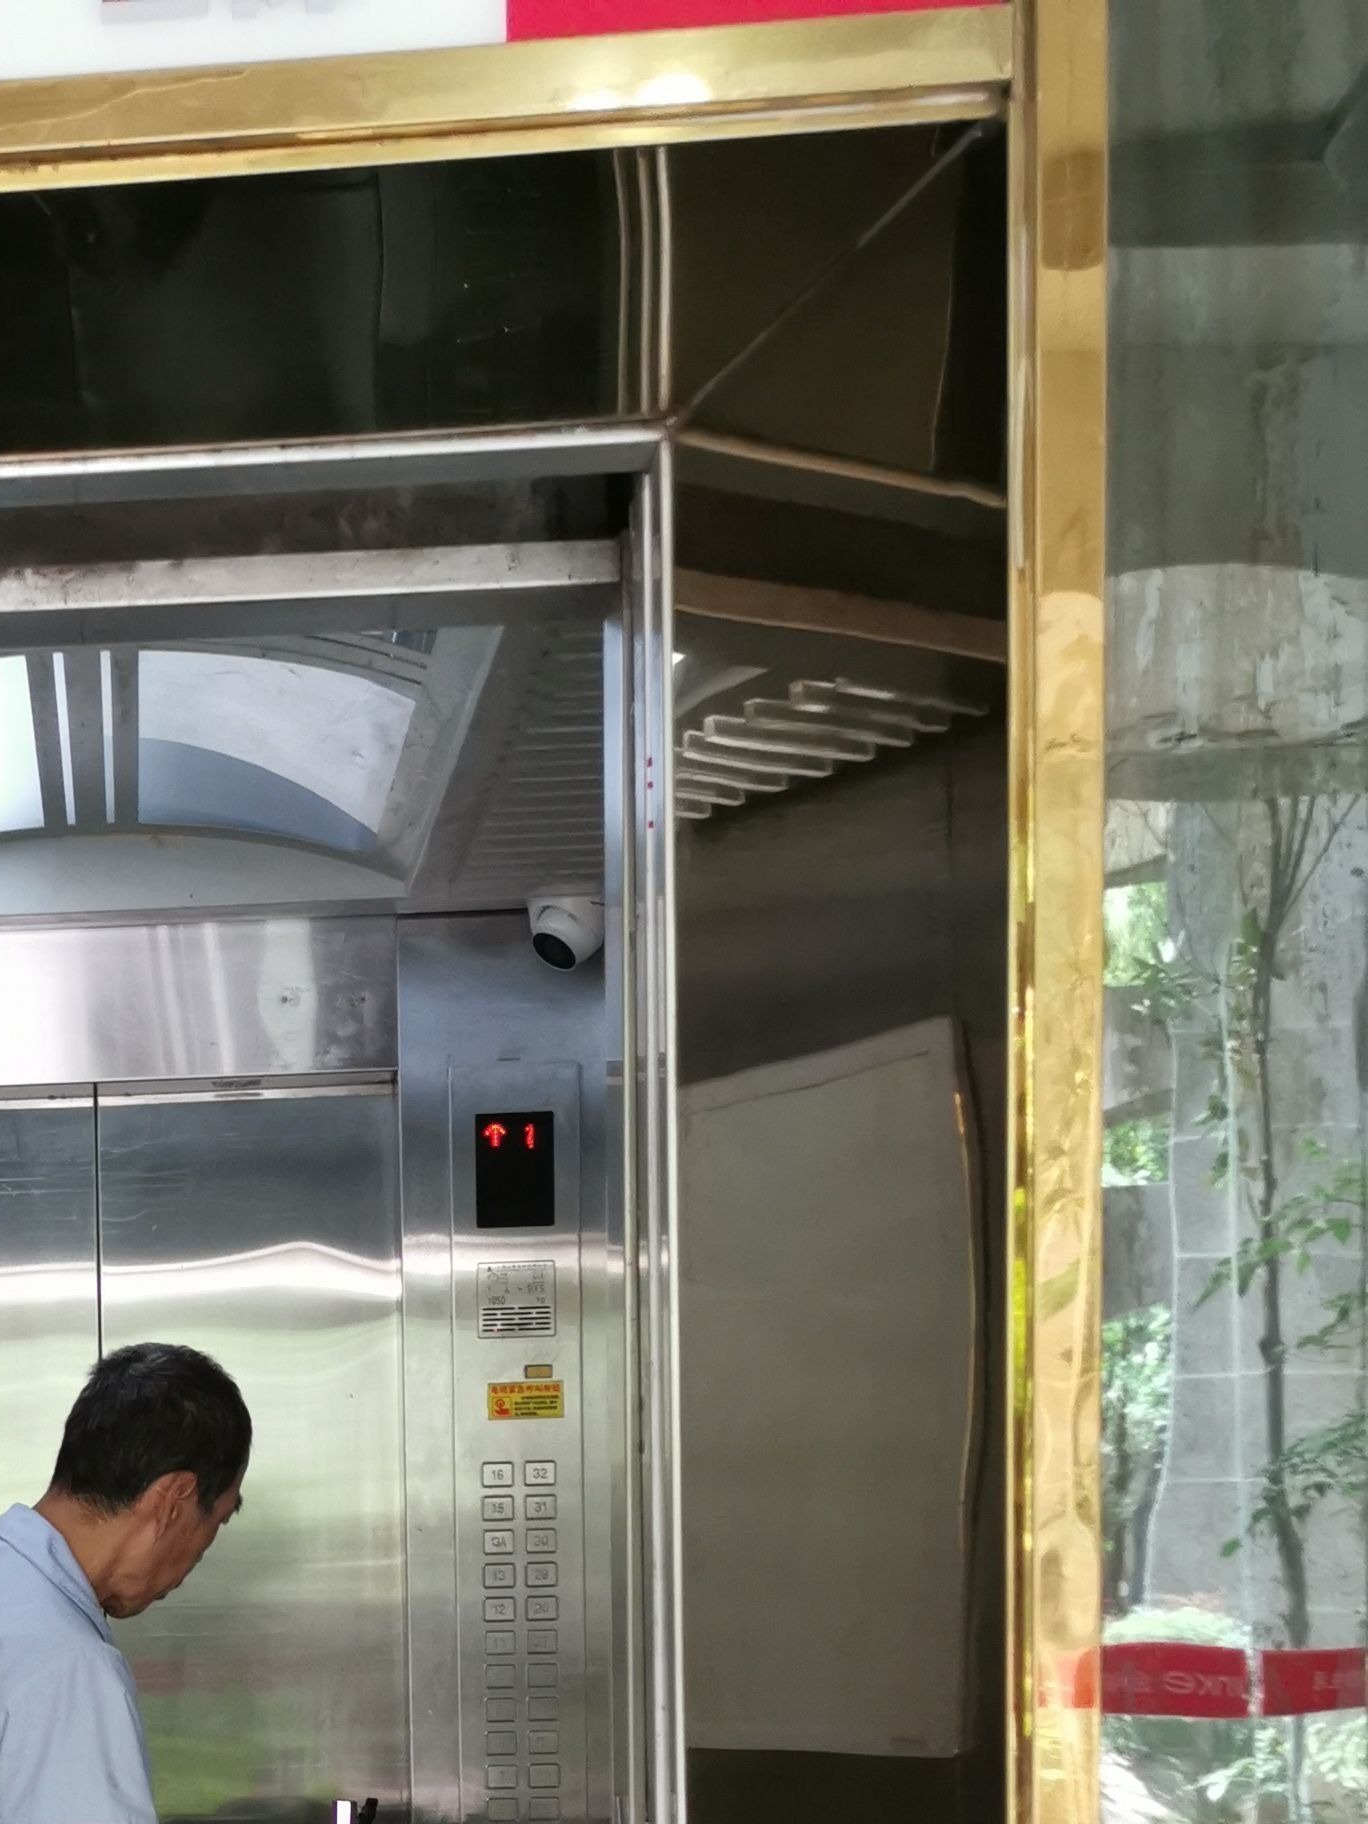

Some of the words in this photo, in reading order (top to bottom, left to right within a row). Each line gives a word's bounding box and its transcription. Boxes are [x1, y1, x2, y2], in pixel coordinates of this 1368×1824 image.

[524, 1123, 535, 1149] 1
[491, 1469, 504, 1480] 16
[533, 1468, 548, 1479] 32
[534, 1501, 547, 1513] 31
[493, 1603, 506, 1615] 12
